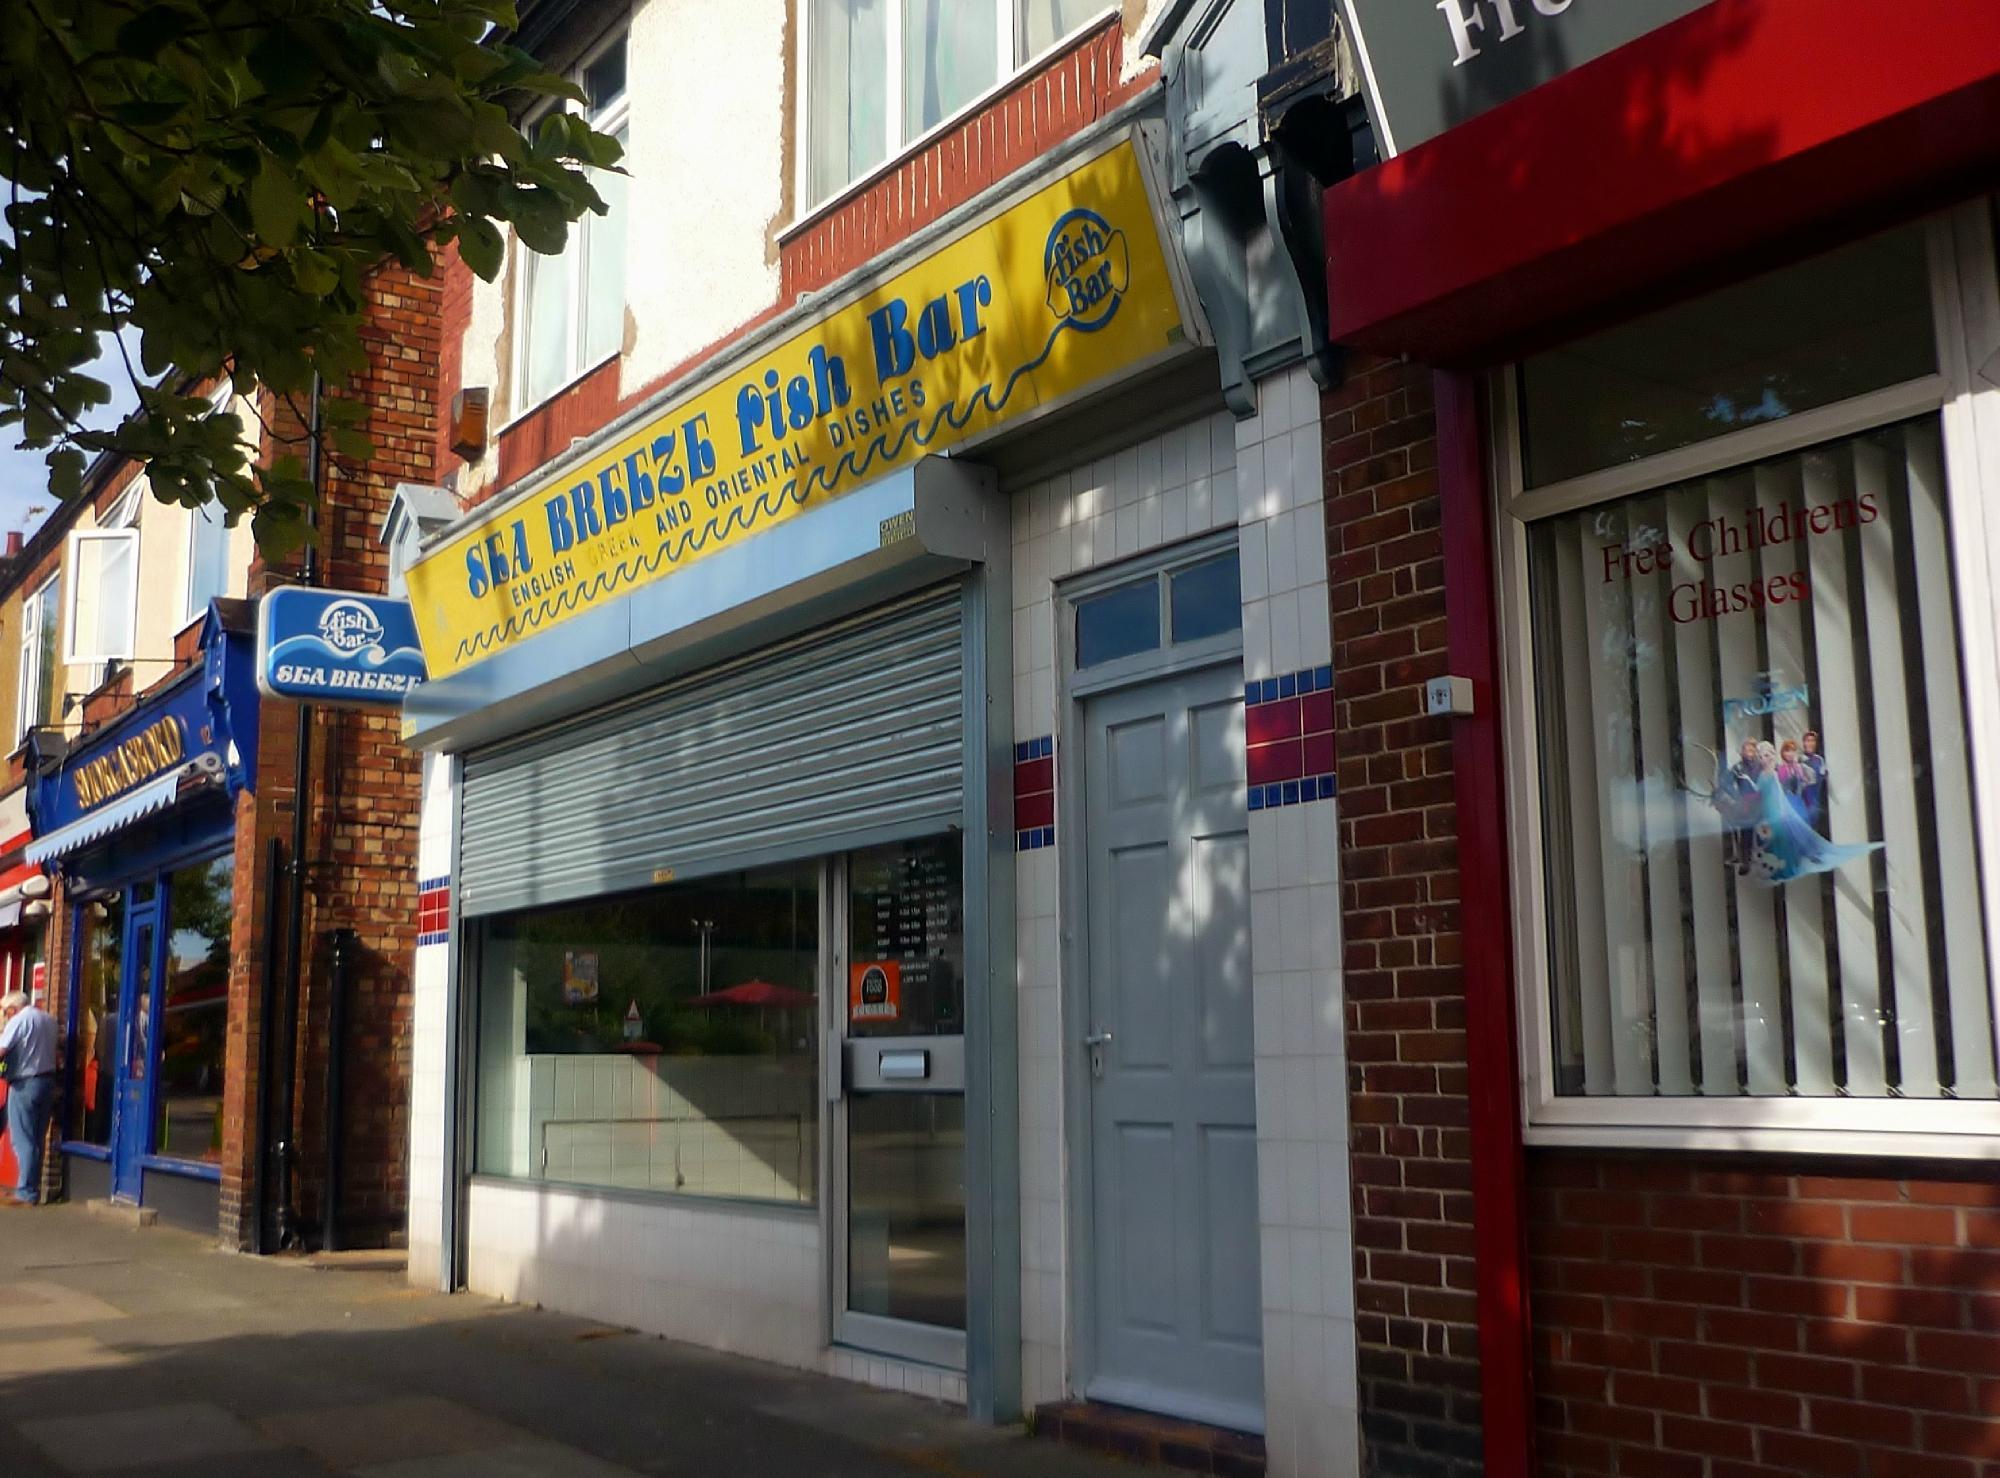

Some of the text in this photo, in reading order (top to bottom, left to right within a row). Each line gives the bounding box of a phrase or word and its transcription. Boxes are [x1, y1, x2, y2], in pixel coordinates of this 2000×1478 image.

[1053, 222, 1103, 287] fish
[1065, 260, 1115, 315] Bar
[465, 275, 991, 599] SEA BREEZE fish Bar
[511, 559, 576, 607] ENGLISH
[656, 500, 692, 535] AND
[705, 441, 810, 510] ORIENTAL
[829, 379, 926, 448] DISHES
[1601, 492, 1878, 584] Free Childrens
[330, 610, 368, 631] fish
[1668, 569, 1809, 624] Glasses
[333, 629, 365, 648] Bar
[276, 664, 422, 692] SEA BREEZE
